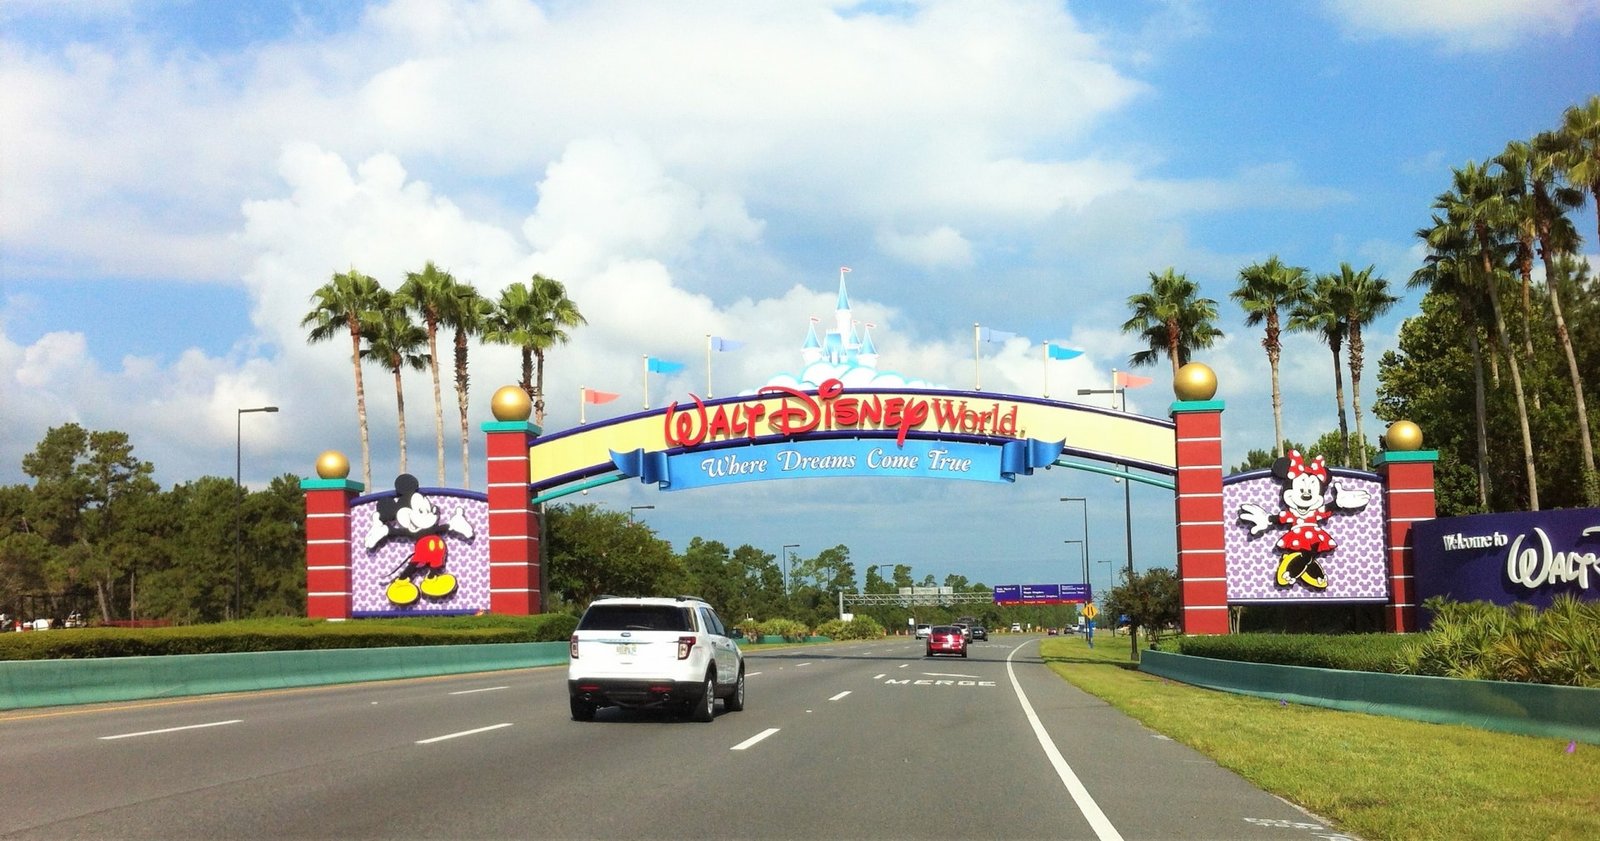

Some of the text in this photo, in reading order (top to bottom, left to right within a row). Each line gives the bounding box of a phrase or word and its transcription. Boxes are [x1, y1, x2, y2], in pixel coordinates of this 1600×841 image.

[702, 447, 972, 477] Where Dreams Come True
[1443, 531, 1509, 551] Welcome to
[885, 678, 997, 687] MERGE
